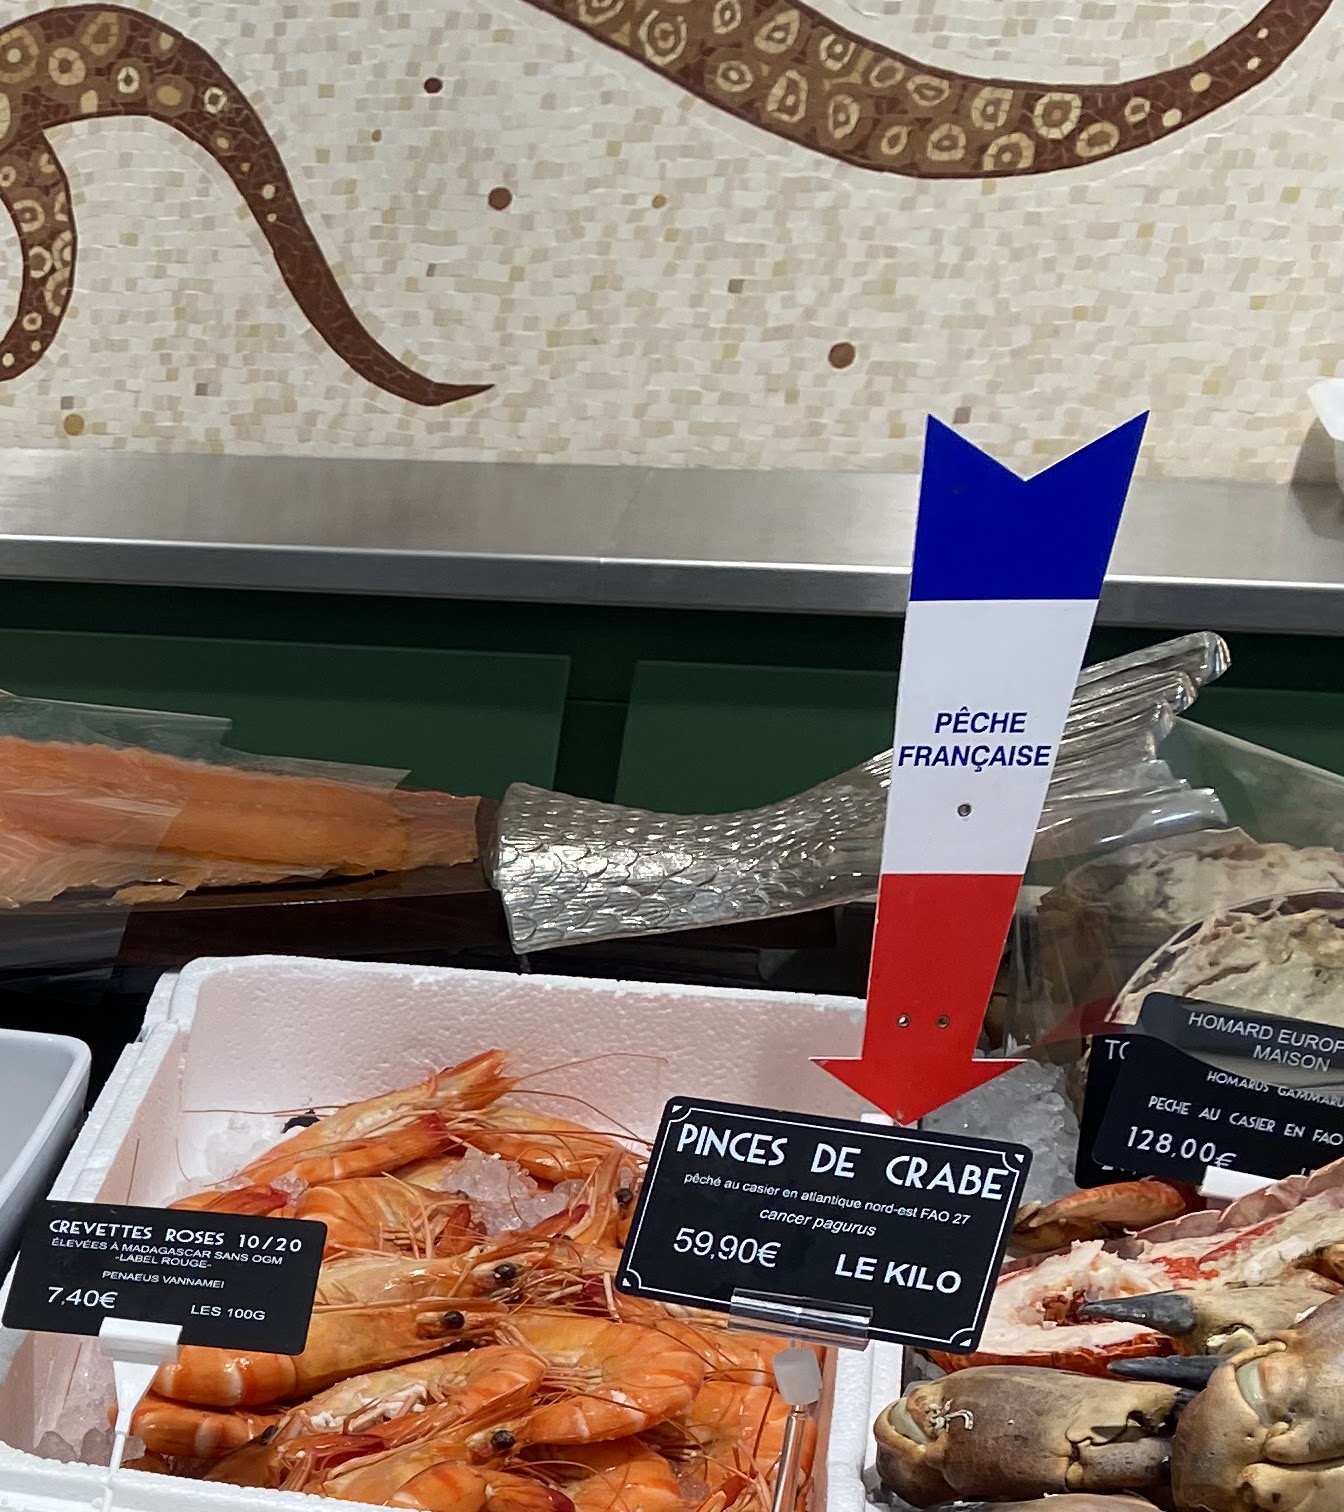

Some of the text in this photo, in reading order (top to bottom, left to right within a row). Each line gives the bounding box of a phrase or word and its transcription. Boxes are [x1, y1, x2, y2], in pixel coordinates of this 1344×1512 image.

[934, 706, 1027, 734] PÊCHE
[898, 745, 1052, 772] FRANÇAISE
[1188, 1011, 1273, 1040] HOMARD
[1252, 1044, 1331, 1072] MAISON
[676, 1123, 1009, 1201] PINCES DE CRABE
[684, 1171, 971, 1226] pêché au casier en atlantique nord-est FAO 27
[49, 1219, 302, 1253] CREVETTES ROSES 10/20
[759, 1207, 877, 1237] cancer pagurus
[835, 1253, 878, 1281] LE
[884, 1262, 962, 1294] KILO
[191, 1304, 221, 1317] LES
[227, 1307, 266, 1321] 100G
